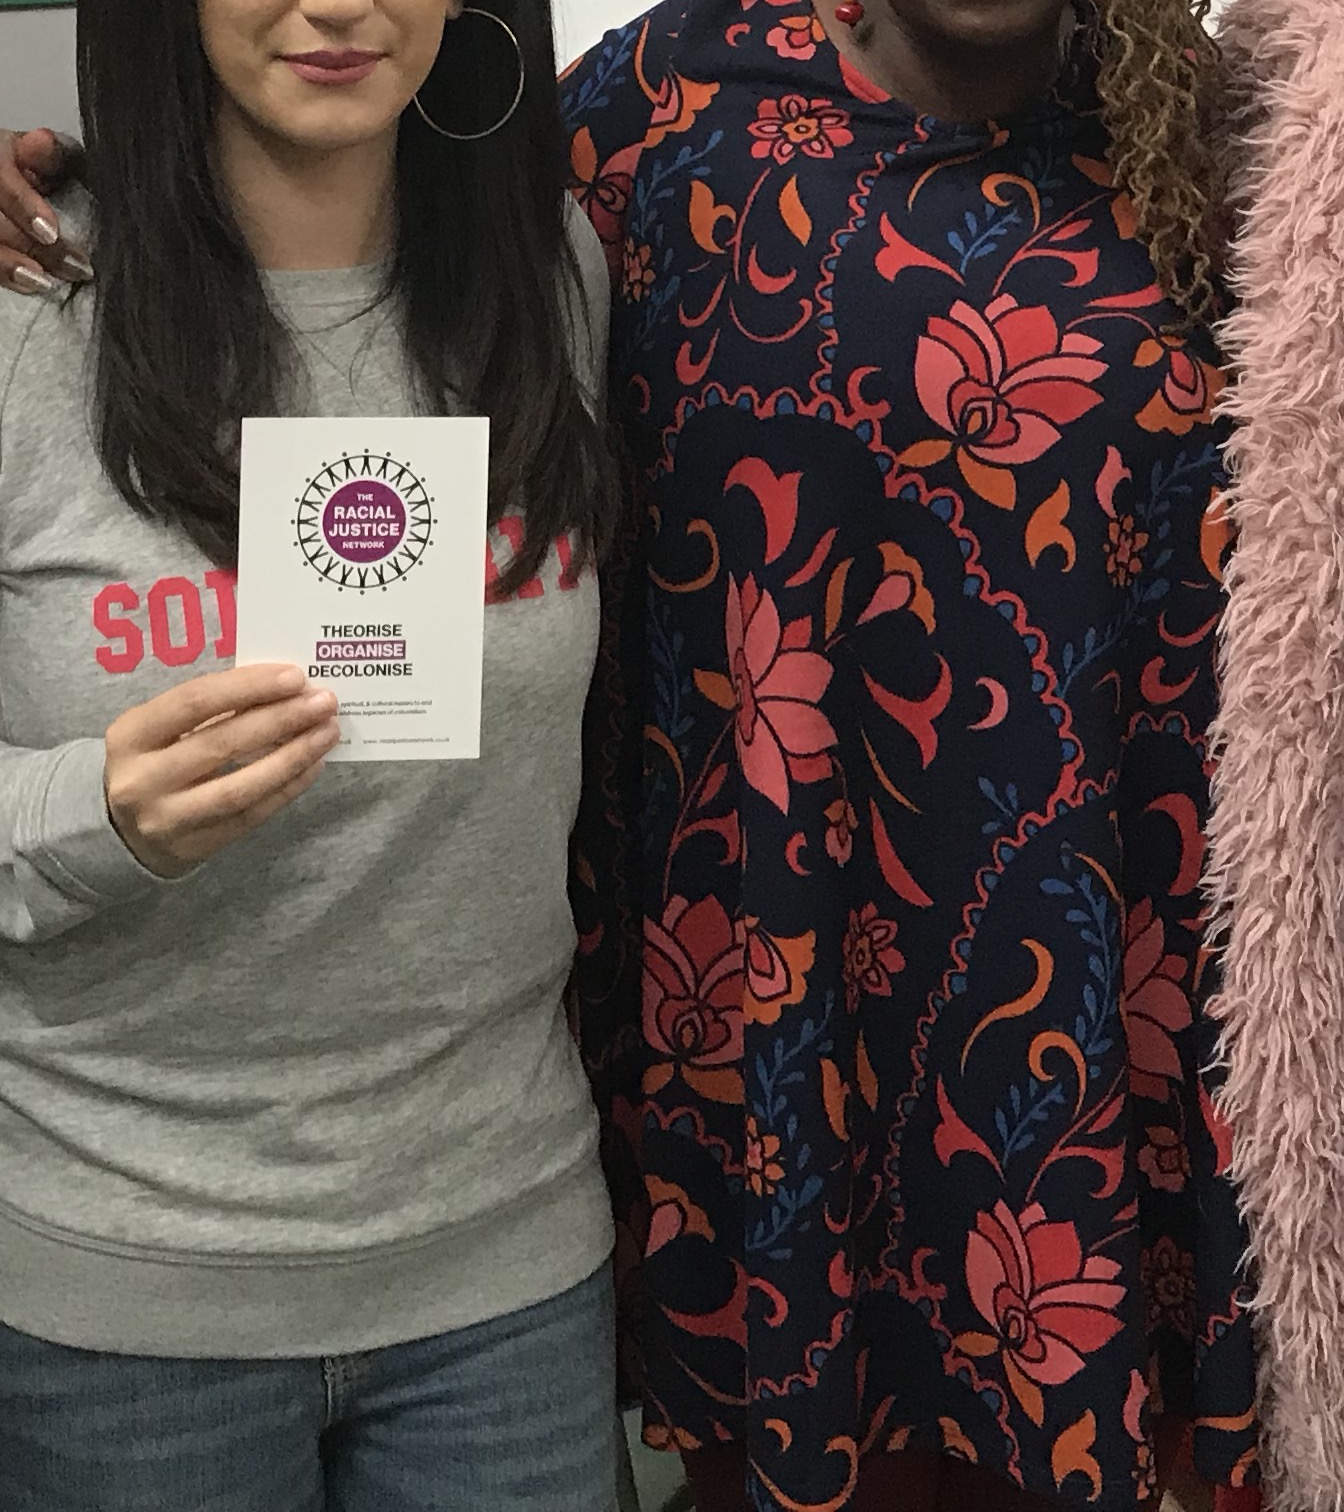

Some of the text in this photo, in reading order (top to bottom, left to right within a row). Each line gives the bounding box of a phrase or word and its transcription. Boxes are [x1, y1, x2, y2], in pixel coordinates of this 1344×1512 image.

[356, 493, 374, 502] THE
[333, 505, 396, 520] RACIAL
[328, 522, 400, 537] JUSTICE
[342, 541, 385, 549] NETWORK
[321, 624, 403, 638] THEORISE
[318, 642, 404, 659] ORGANISE
[308, 663, 414, 678] DECOLONISE
